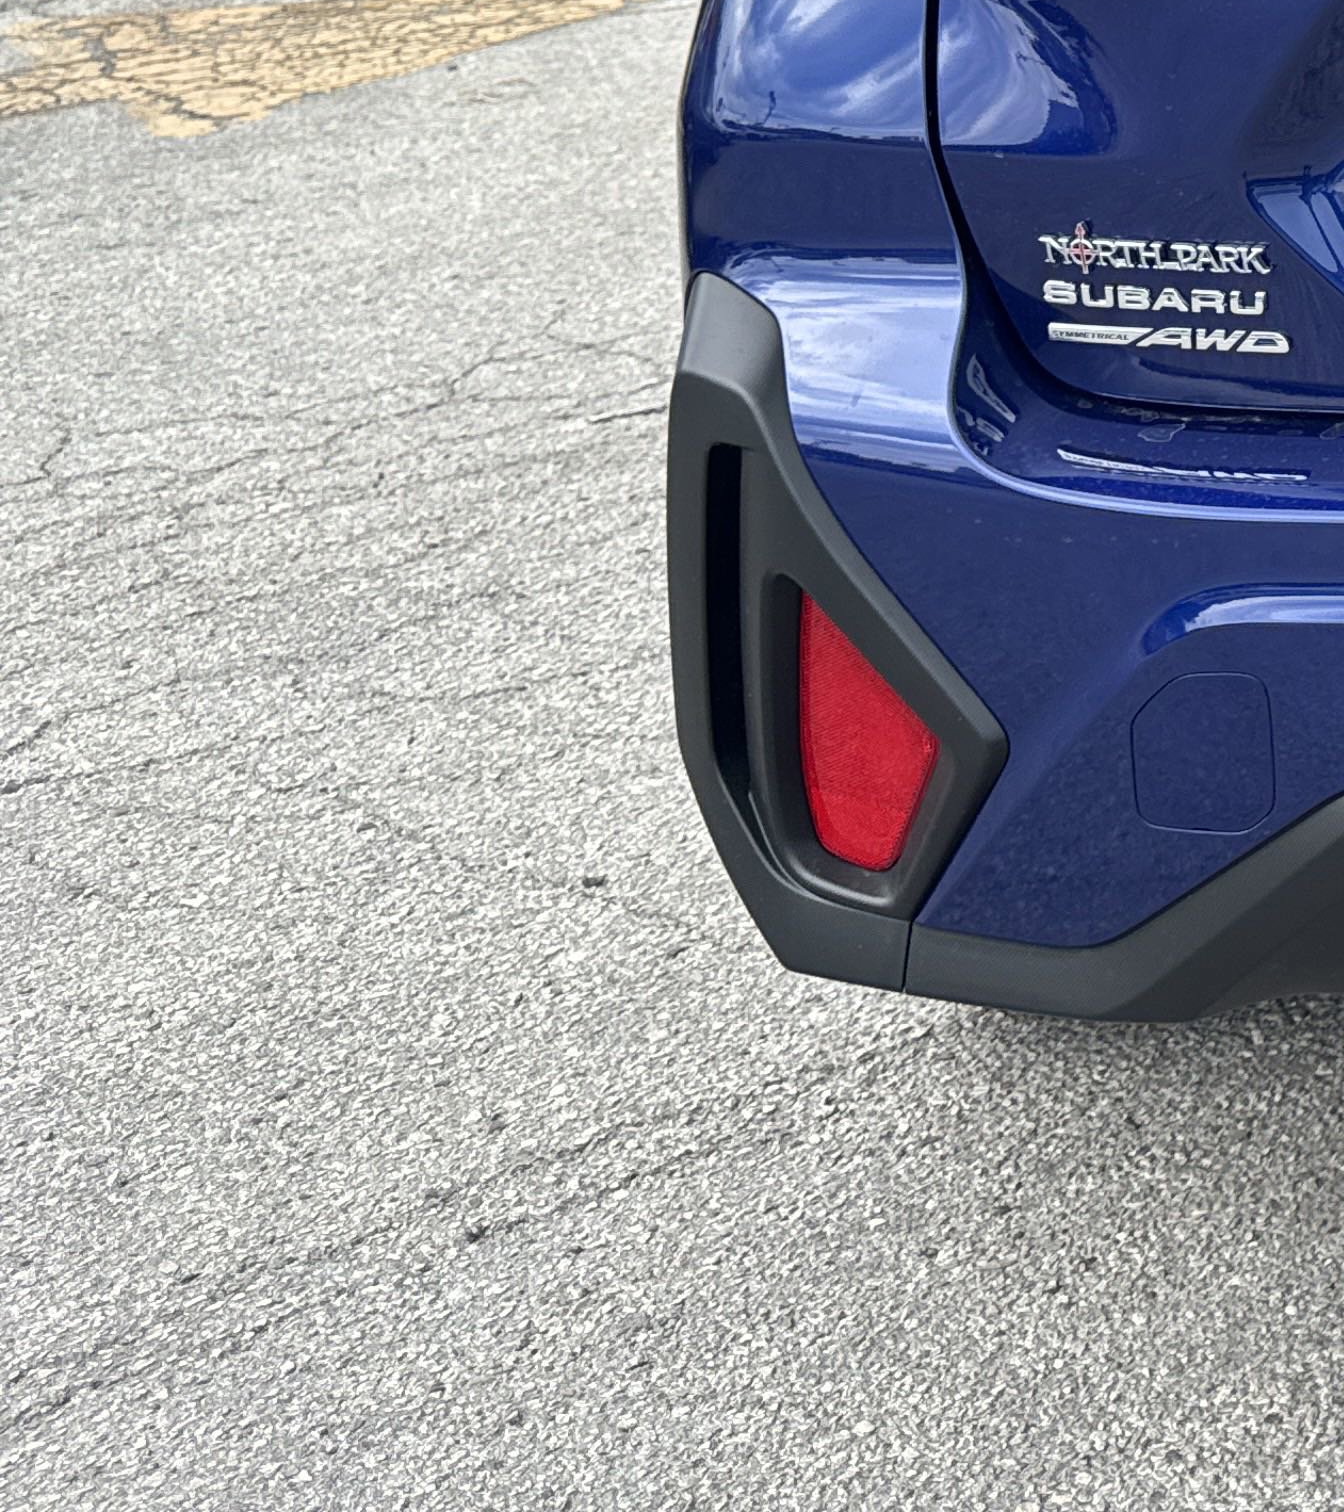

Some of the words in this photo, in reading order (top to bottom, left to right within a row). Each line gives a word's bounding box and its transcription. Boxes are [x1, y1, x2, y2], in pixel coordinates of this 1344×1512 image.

[1038, 234, 1165, 273] NORTH
[1166, 241, 1273, 275] PARK
[1043, 280, 1267, 316] SUBARU
[1052, 330, 1129, 341] SYMMETRICAL
[1135, 327, 1290, 354] AWD
